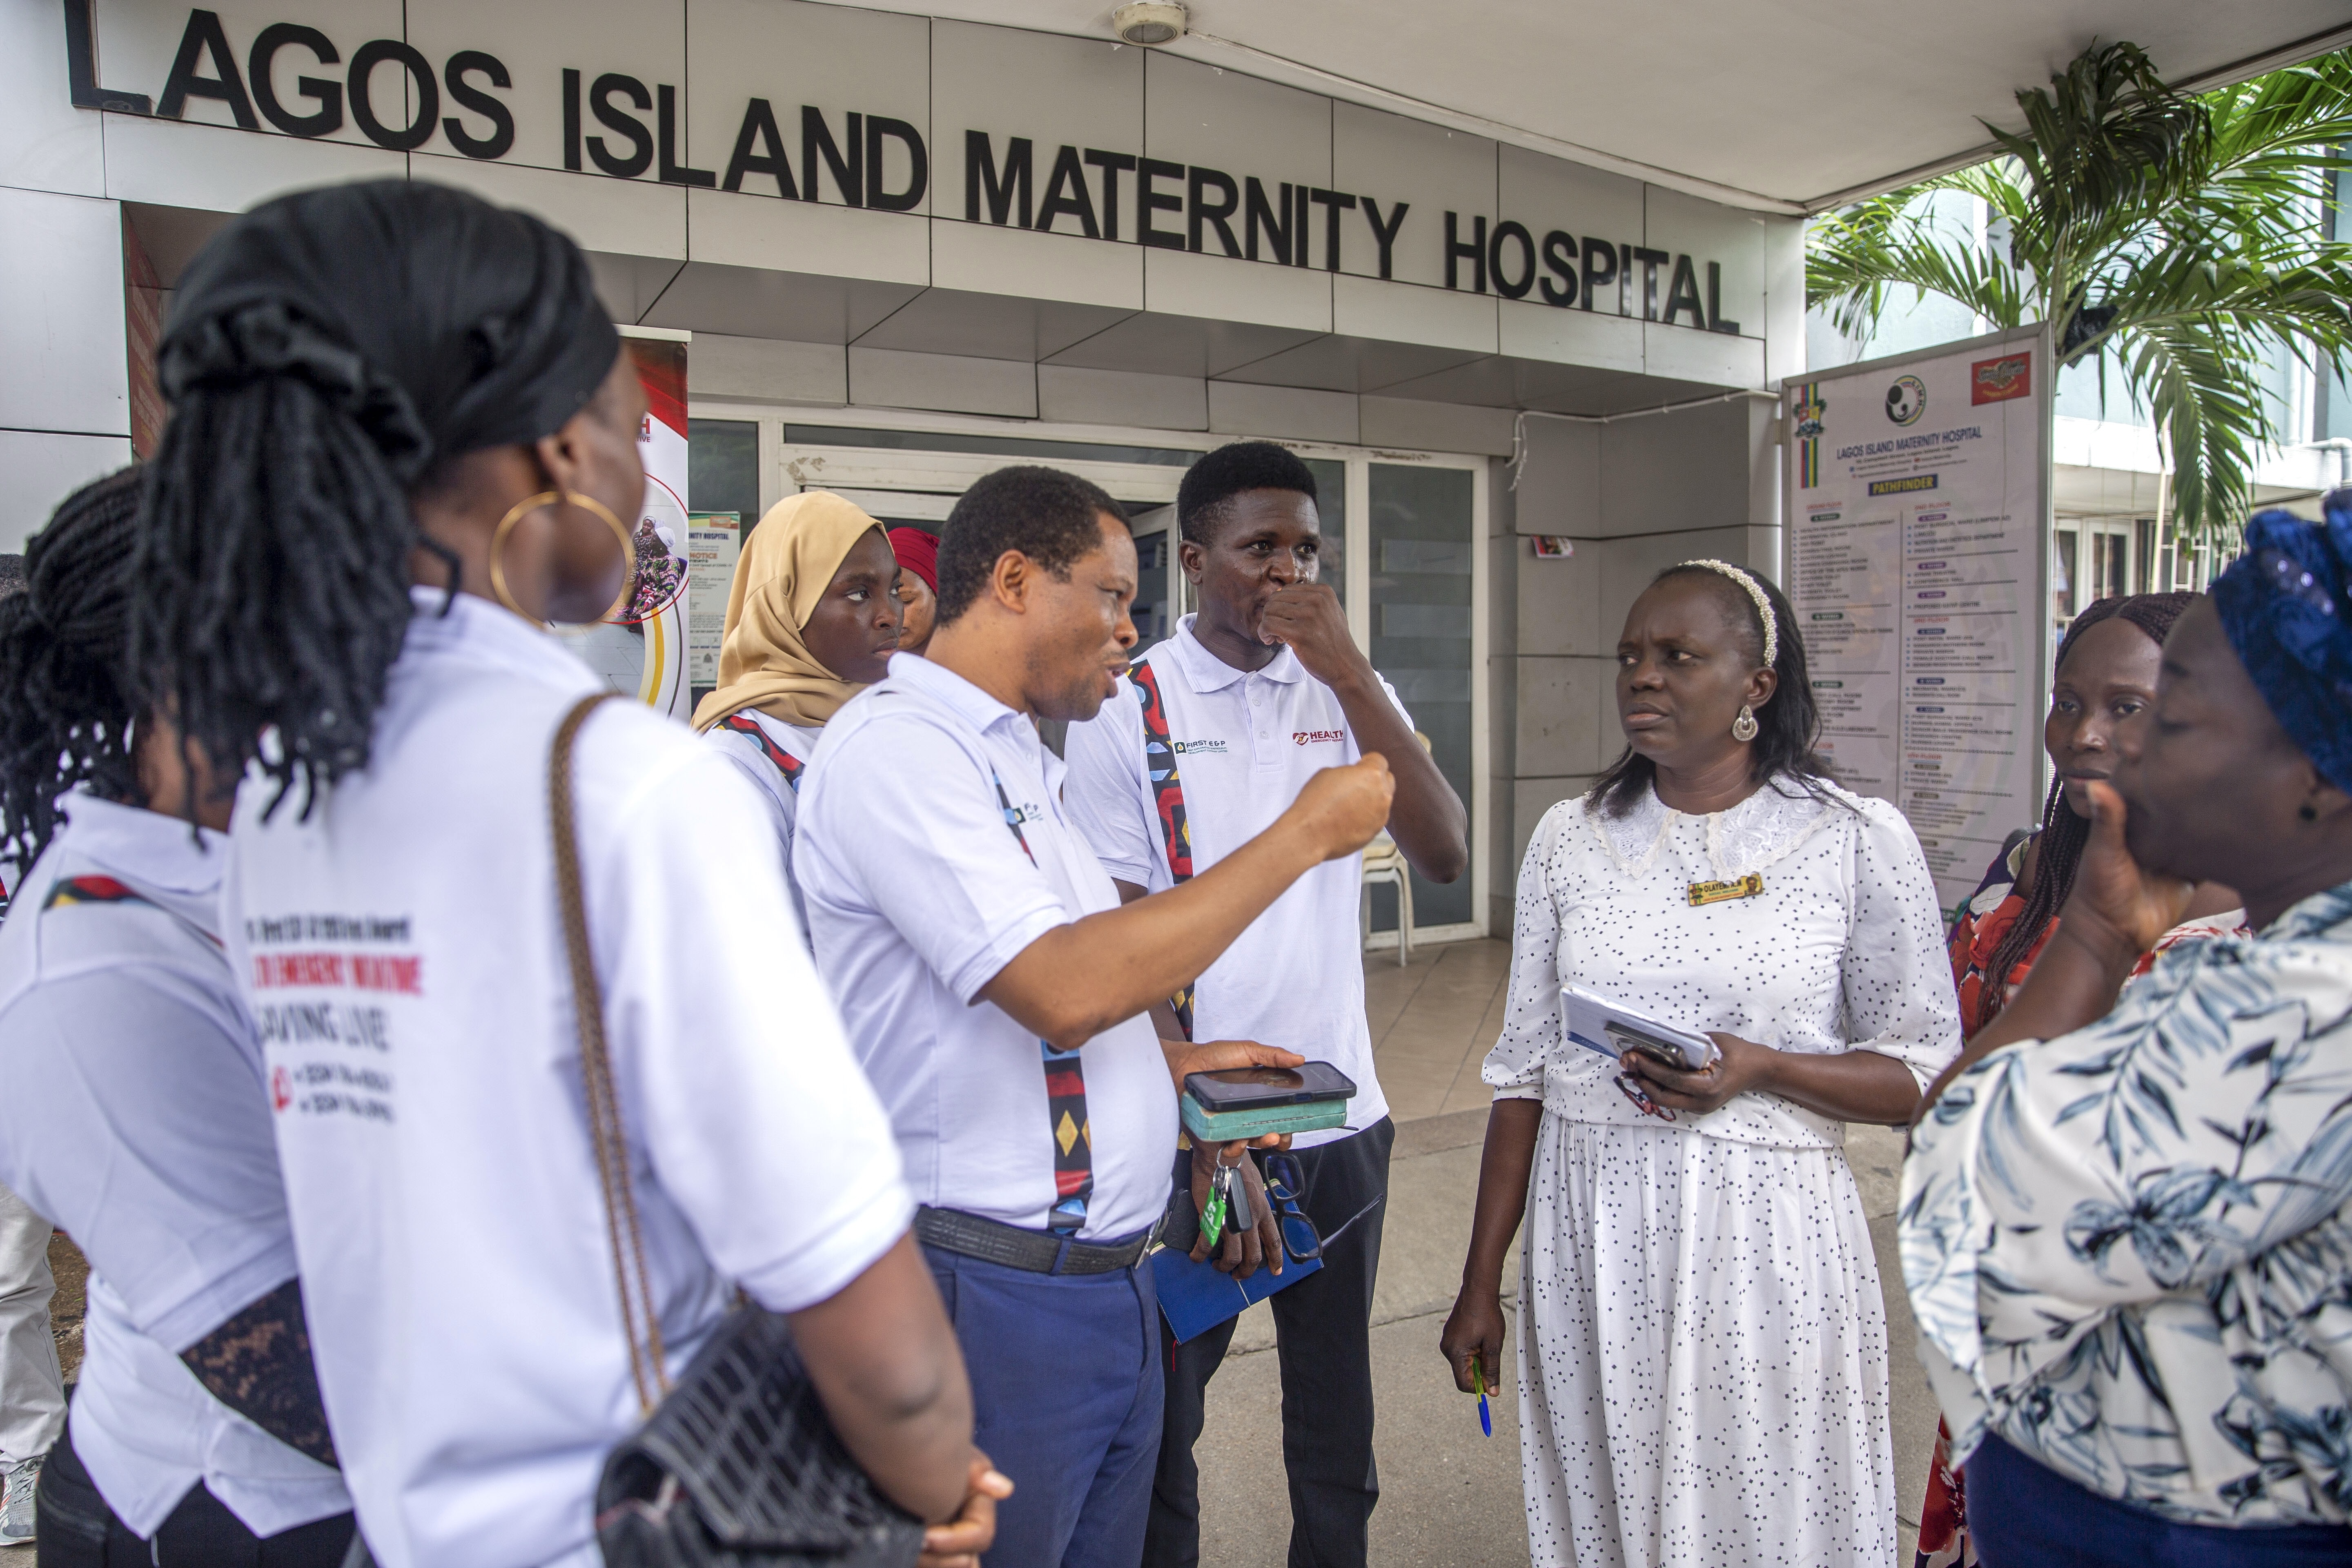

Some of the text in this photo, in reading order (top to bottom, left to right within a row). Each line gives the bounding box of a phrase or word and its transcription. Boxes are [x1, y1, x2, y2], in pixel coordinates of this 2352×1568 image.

[64, 0, 1740, 334] LAGOS ISLAND MATERNITY HOSPITAL
[1837, 425, 1982, 460] LAGOS ISLAND MATERNITY HOSPITAL
[1872, 476, 1933, 494] PATHFINDER
[704, 532, 729, 541] HOSPITAL
[1310, 730, 1343, 739] HEALTH
